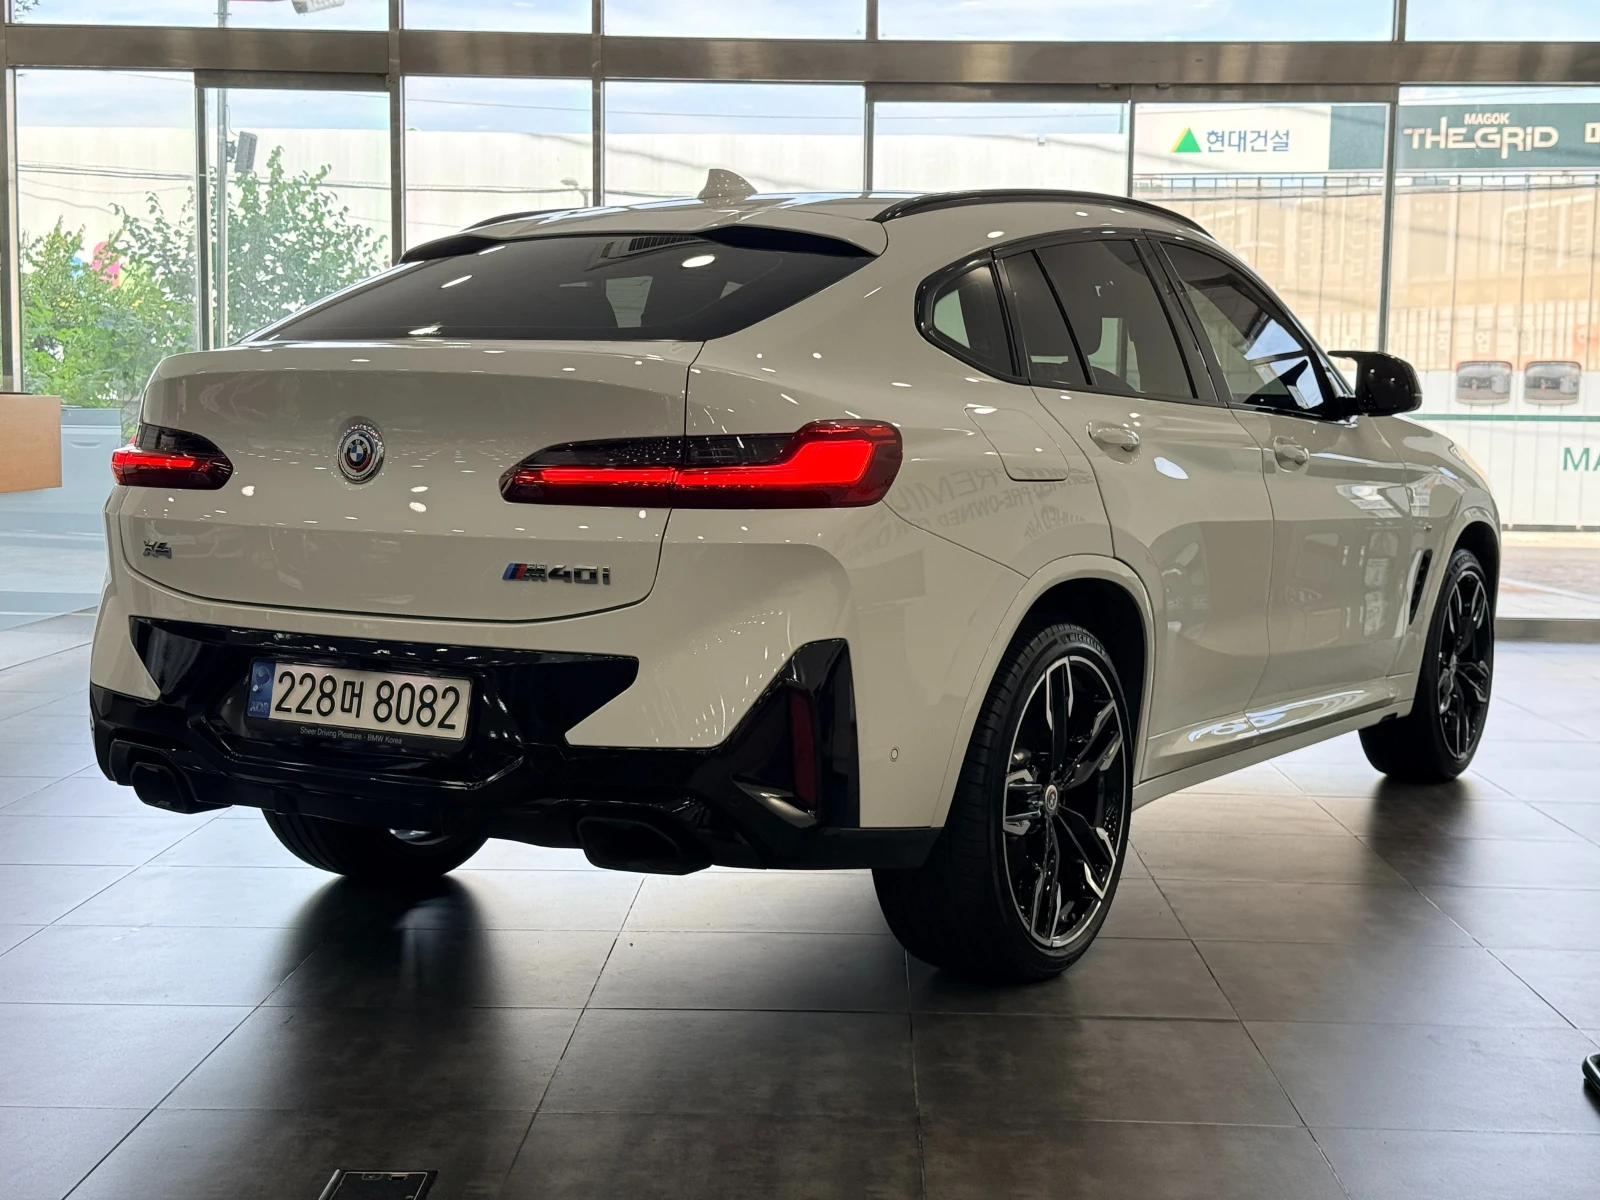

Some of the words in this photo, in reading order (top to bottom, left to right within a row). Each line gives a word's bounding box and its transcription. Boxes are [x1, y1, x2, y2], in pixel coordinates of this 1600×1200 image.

[1464, 112, 1511, 125] MAGOK
[1207, 129, 1290, 153] 현대건설
[373, 680, 460, 730] 8082
[300, 726, 317, 735] Sheer
[317, 728, 337, 739] Driving
[337, 730, 362, 740] Pleasure
[367, 733, 384, 743] BMW
[384, 736, 403, 745] Korea
